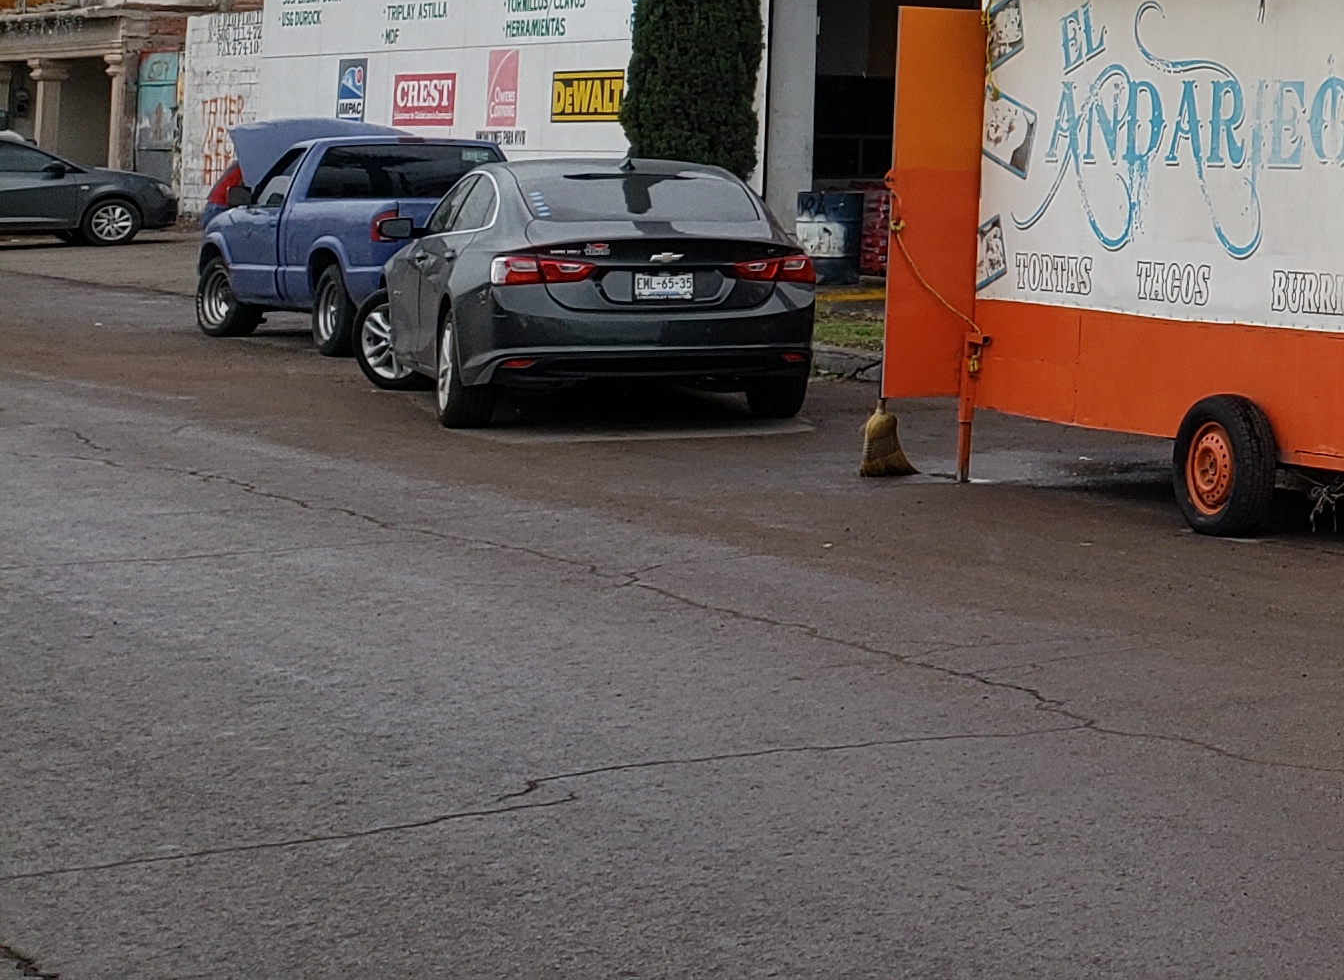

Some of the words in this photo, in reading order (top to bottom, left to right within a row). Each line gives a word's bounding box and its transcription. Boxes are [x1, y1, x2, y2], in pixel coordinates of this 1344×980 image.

[387, 3, 416, 21] TRIPLAY
[418, 2, 447, 19] ASTILLA
[505, 18, 566, 38] HERRAMIENTAS
[1060, 0, 1108, 75] EL
[396, 79, 453, 108] CREST
[340, 102, 362, 115] IMPAC
[1016, 252, 1093, 296] TORTAS
[1137, 262, 1211, 306] TACOS
